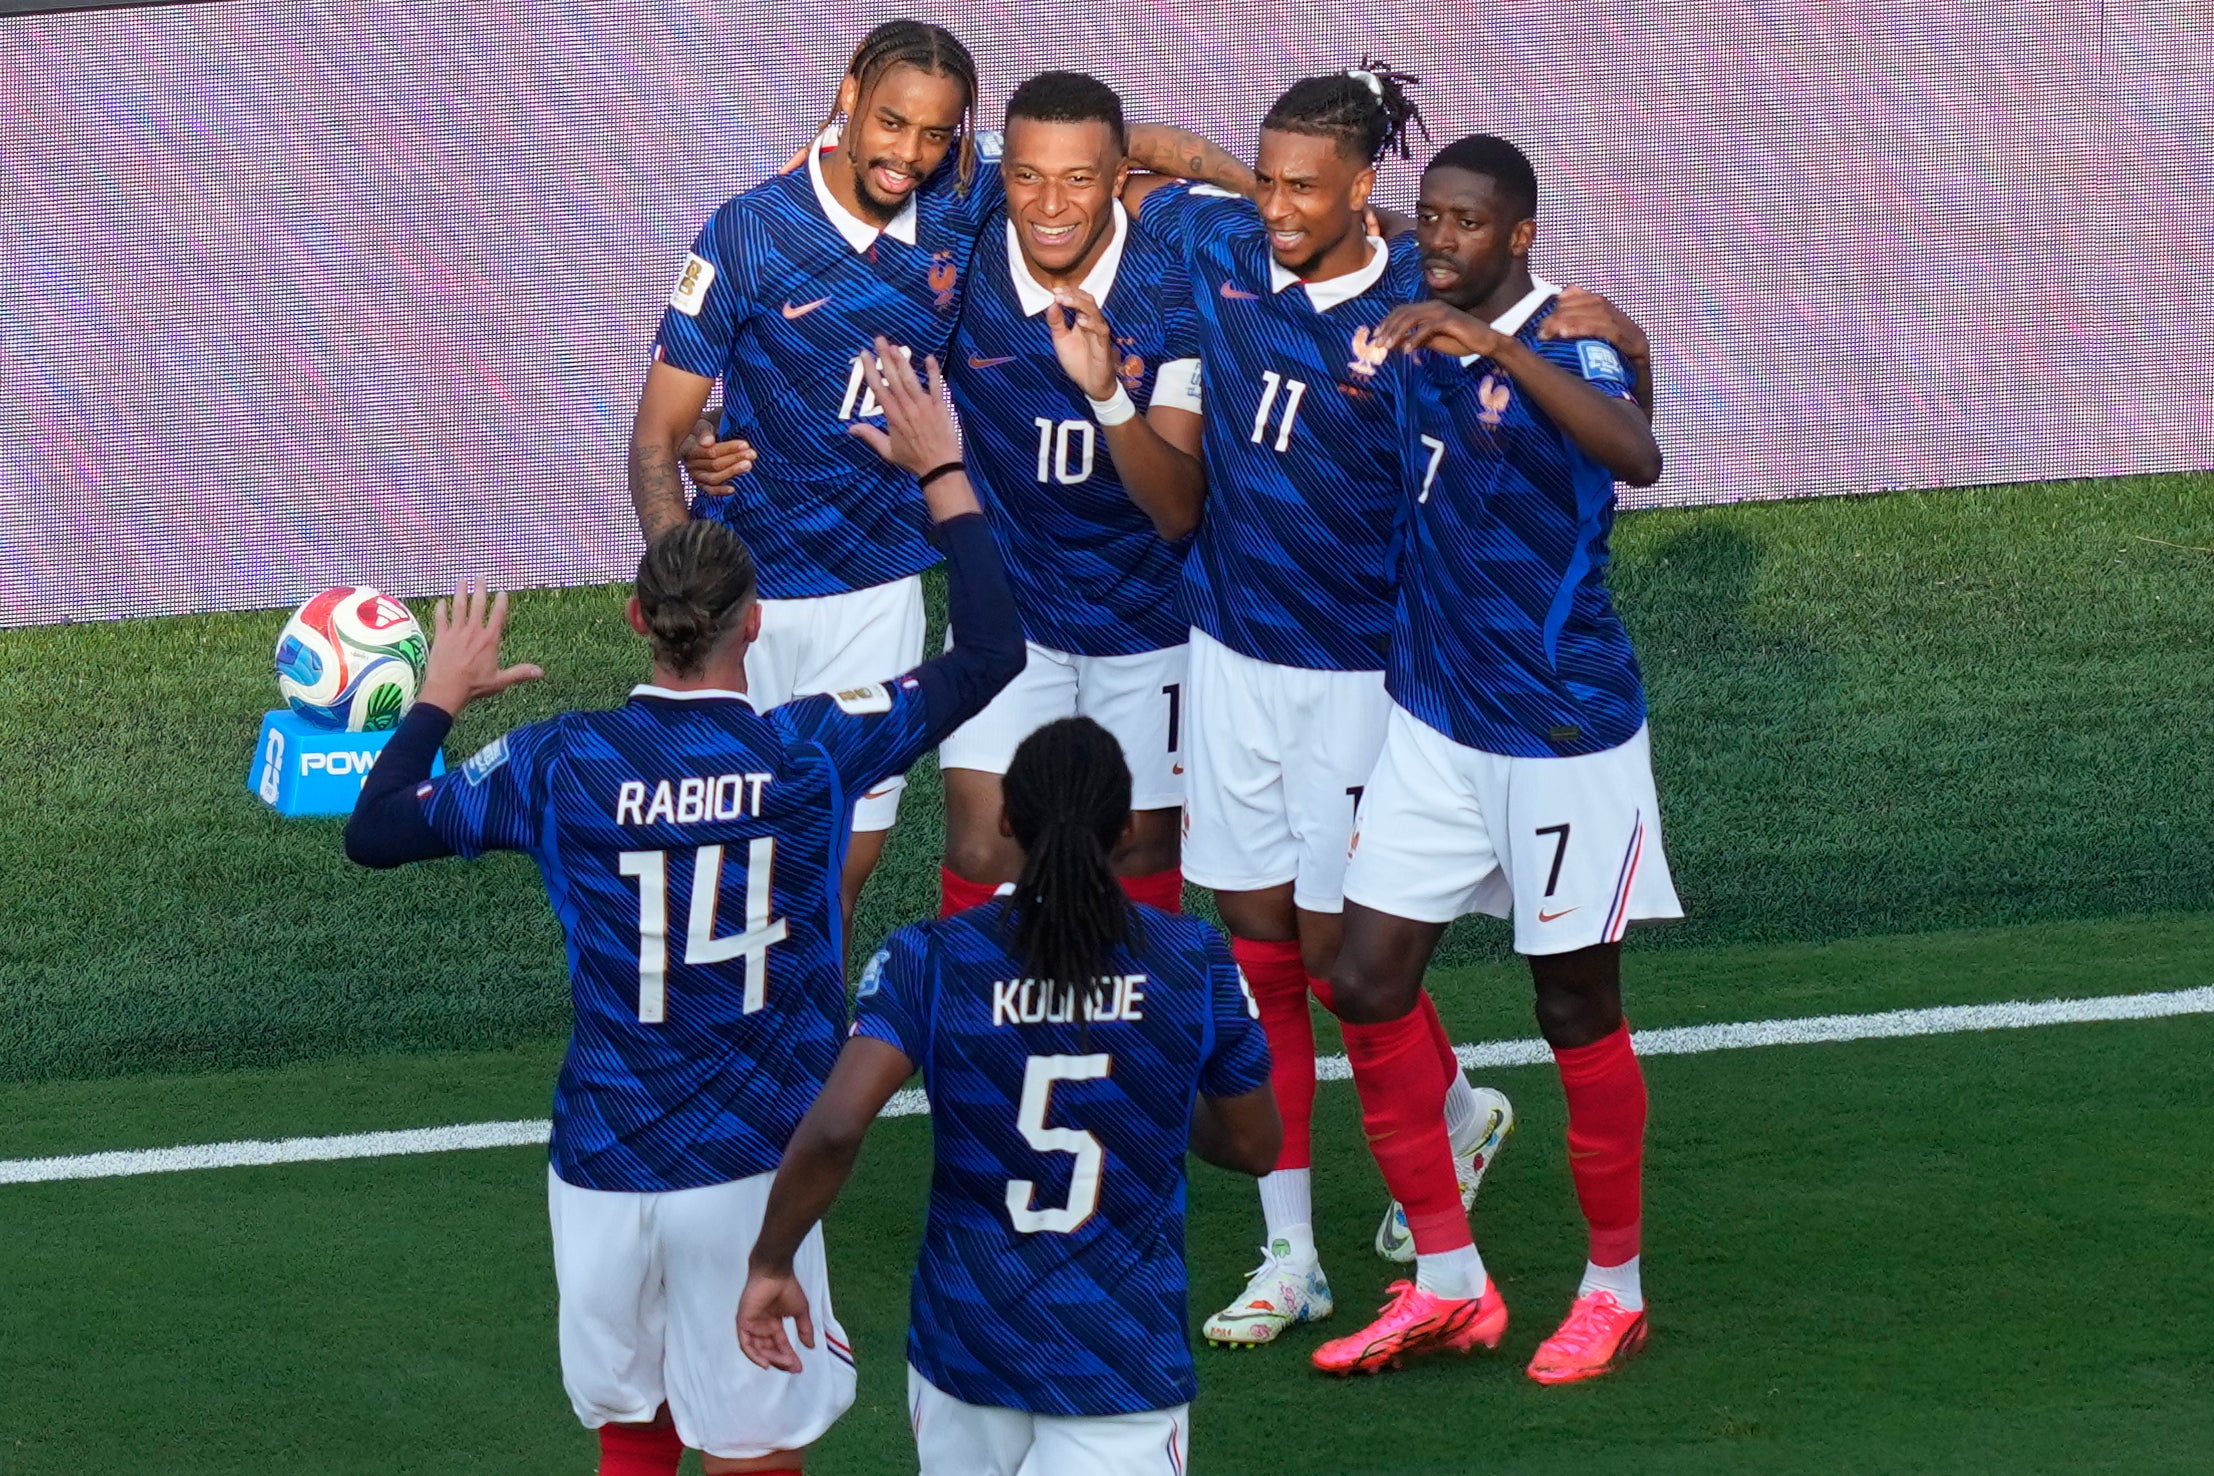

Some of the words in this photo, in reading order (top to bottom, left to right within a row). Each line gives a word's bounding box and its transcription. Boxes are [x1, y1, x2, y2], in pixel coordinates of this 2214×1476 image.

[1251, 370, 1306, 452] 11
[1035, 417, 1094, 485] 10
[1420, 434, 1445, 504] 7
[1162, 684, 1180, 752] 1
[301, 751, 381, 776] POW
[617, 773, 772, 825] RABIOT
[1535, 823, 1570, 896] 7
[619, 838, 789, 1022] 14
[1005, 1054, 1112, 1233] 5
